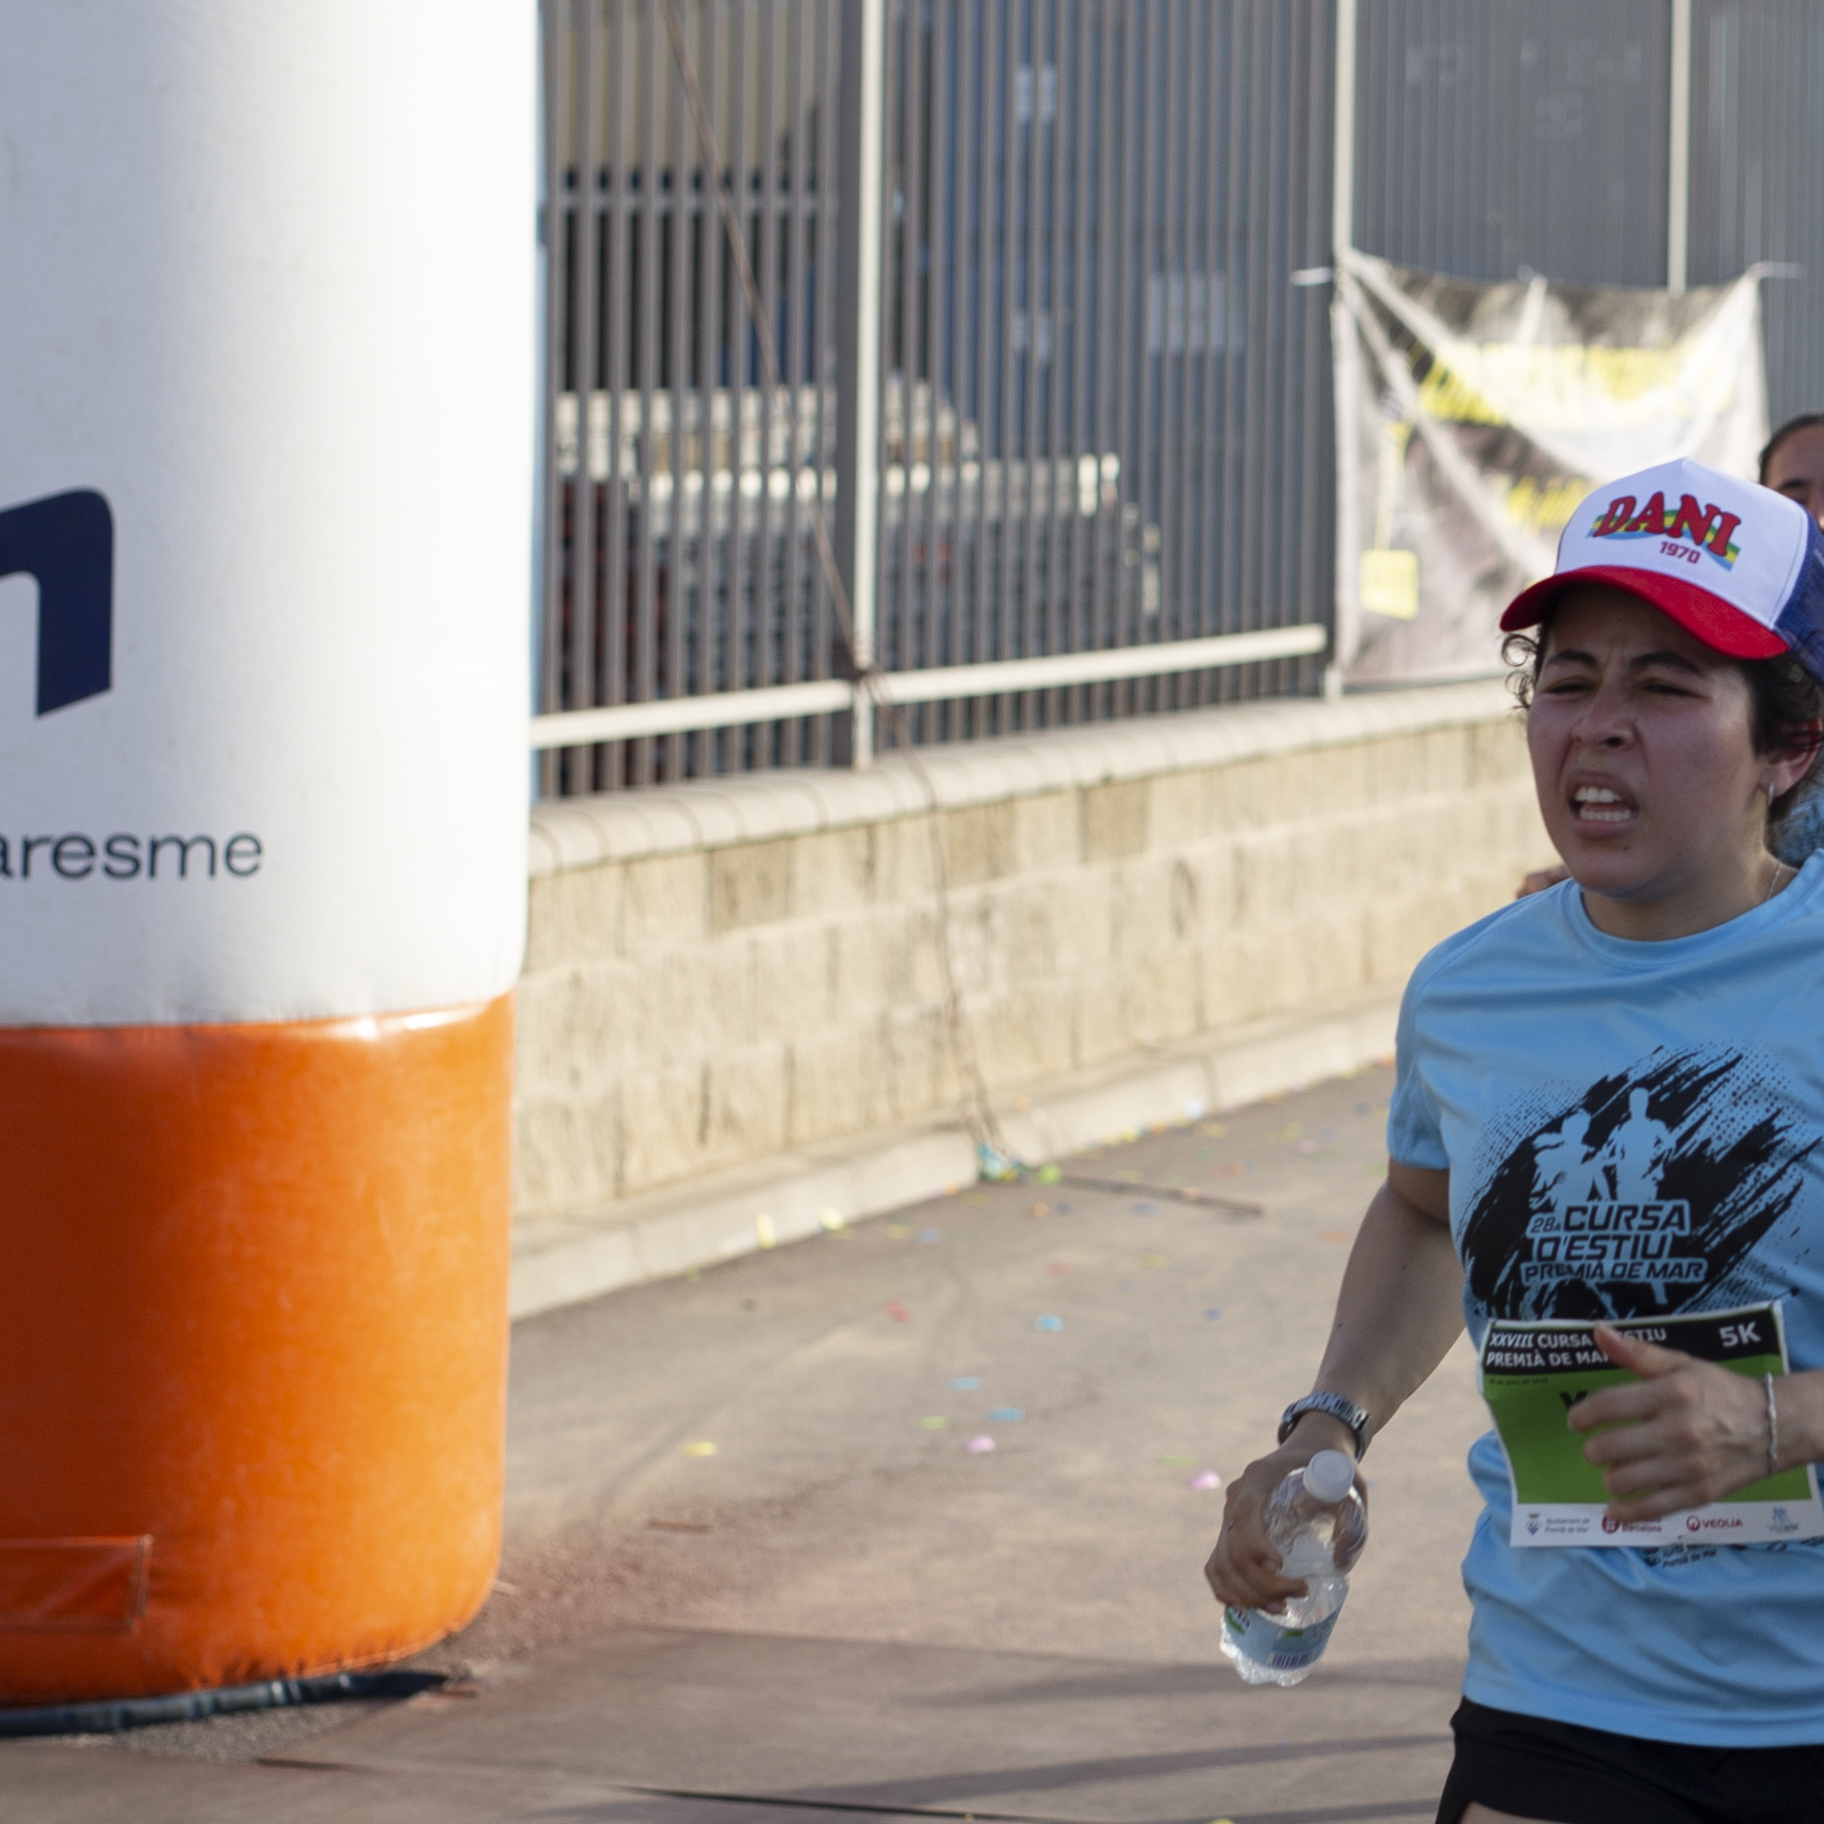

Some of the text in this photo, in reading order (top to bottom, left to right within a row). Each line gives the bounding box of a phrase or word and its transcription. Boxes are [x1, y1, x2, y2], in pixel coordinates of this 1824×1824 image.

[1592, 491, 1741, 557] DANI
[1659, 540, 1702, 564] 1970
[1563, 1203, 1686, 1232] CURSA
[1536, 1234, 1668, 1262] D'ESTIU
[1610, 1262, 1644, 1279] DE
[1645, 1261, 1703, 1279] MAR
[1489, 1331, 1535, 1349] XXVIII
[1537, 1333, 1593, 1349] CURSA
[1718, 1321, 1762, 1348] 5K
[1485, 1349, 1546, 1368] PREMIÀ
[1548, 1351, 1573, 1367] DE
[1702, 1518, 1744, 1529] VEOLIA
